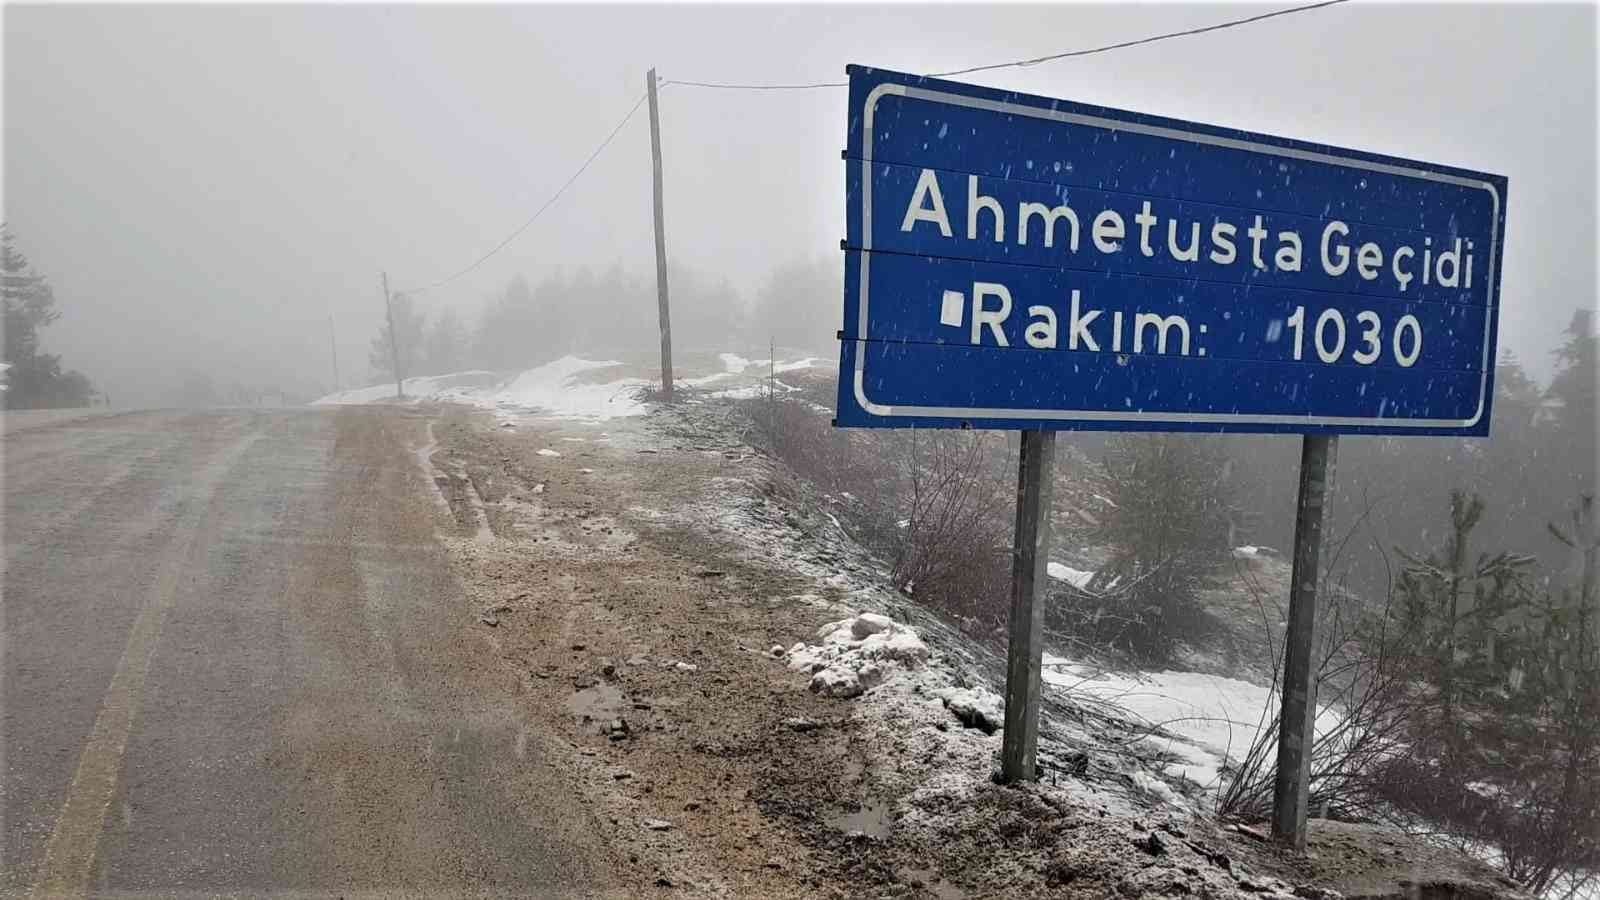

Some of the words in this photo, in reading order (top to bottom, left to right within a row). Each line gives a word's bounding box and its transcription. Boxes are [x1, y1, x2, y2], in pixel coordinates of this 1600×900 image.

[901, 168, 1303, 272] Ahmetusta
[1320, 220, 1474, 291] Geçidi
[970, 282, 1208, 357] Rakım:
[1286, 306, 1423, 368] 1030
